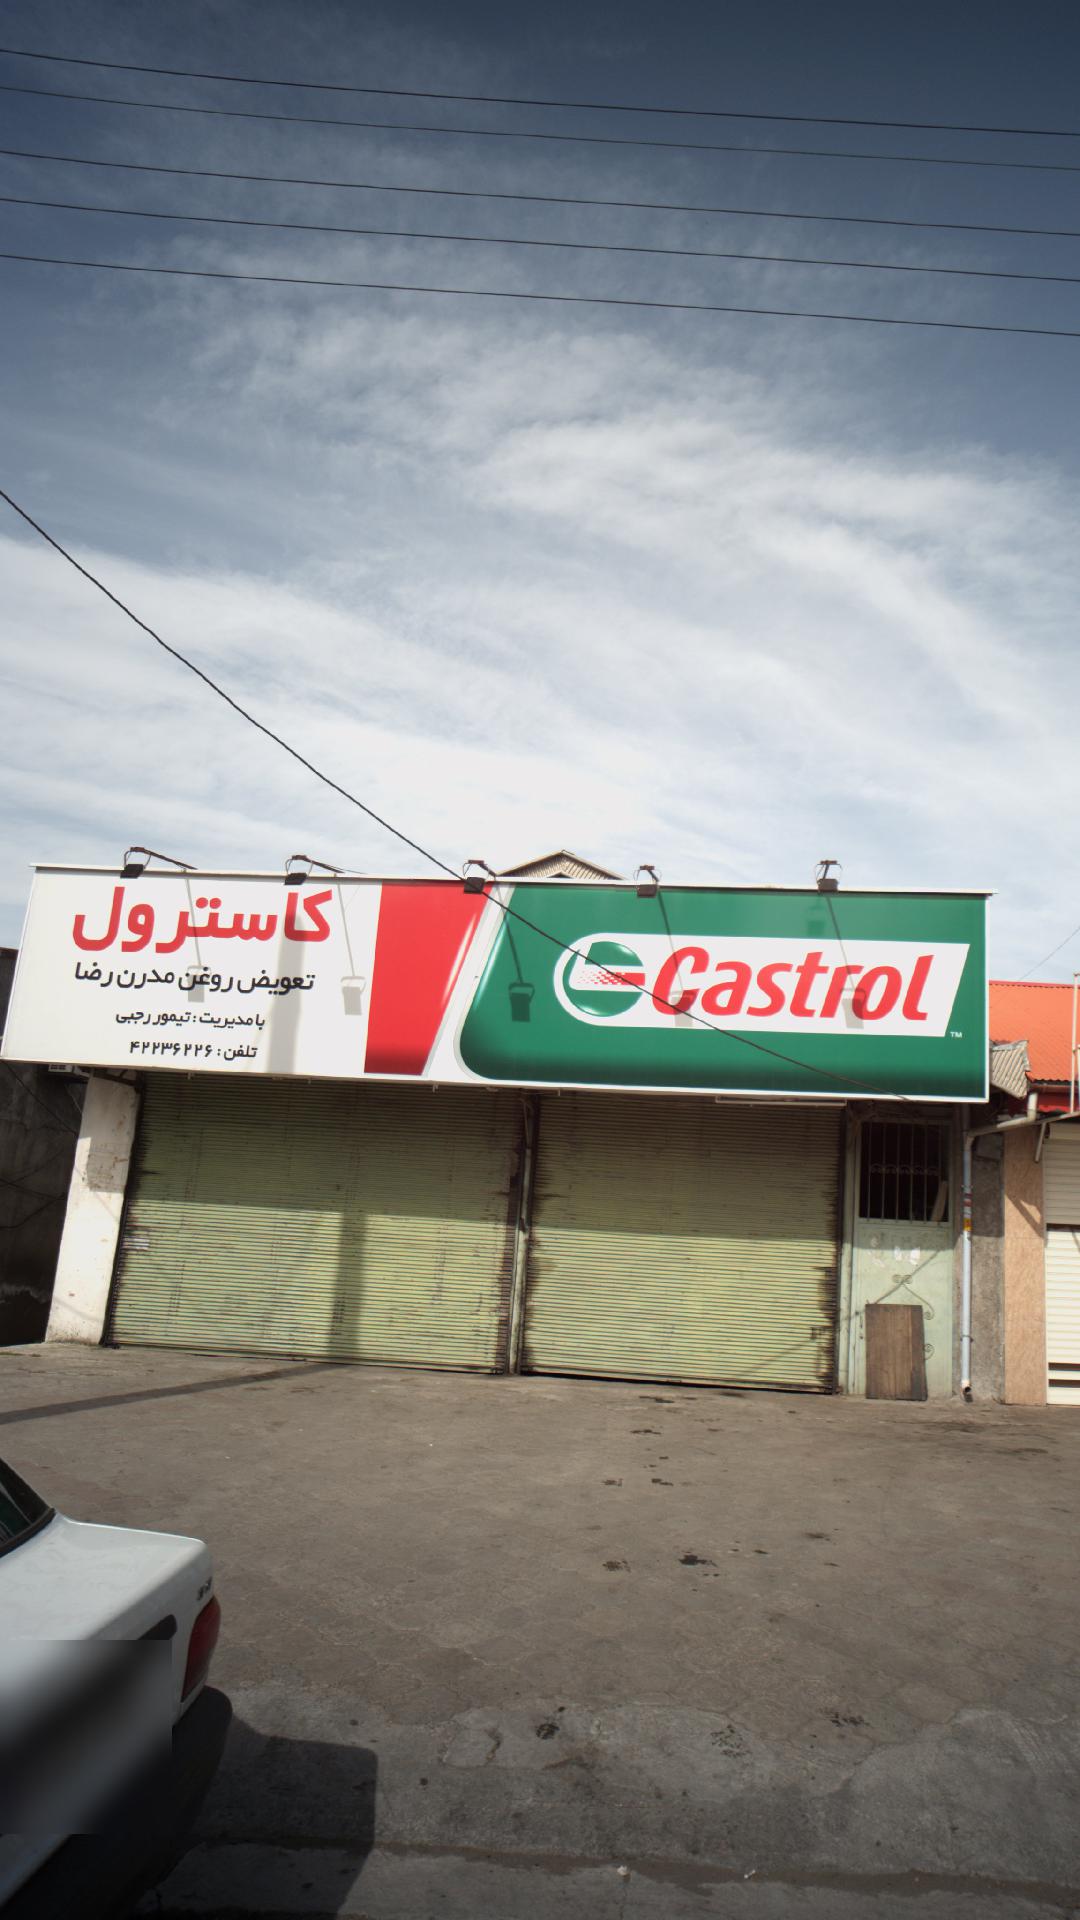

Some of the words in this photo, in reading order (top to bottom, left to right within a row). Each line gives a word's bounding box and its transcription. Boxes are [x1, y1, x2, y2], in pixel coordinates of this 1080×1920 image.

[72, 886, 333, 953] کاسترول
[75, 961, 114, 988] رضا
[116, 968, 175, 989] مدرن
[178, 966, 234, 993] روغن
[237, 969, 316, 996] تعویض
[651, 946, 935, 1021] Castrol
[115, 1011, 151, 1025] رجبی
[152, 1011, 192, 1027] تیمور
